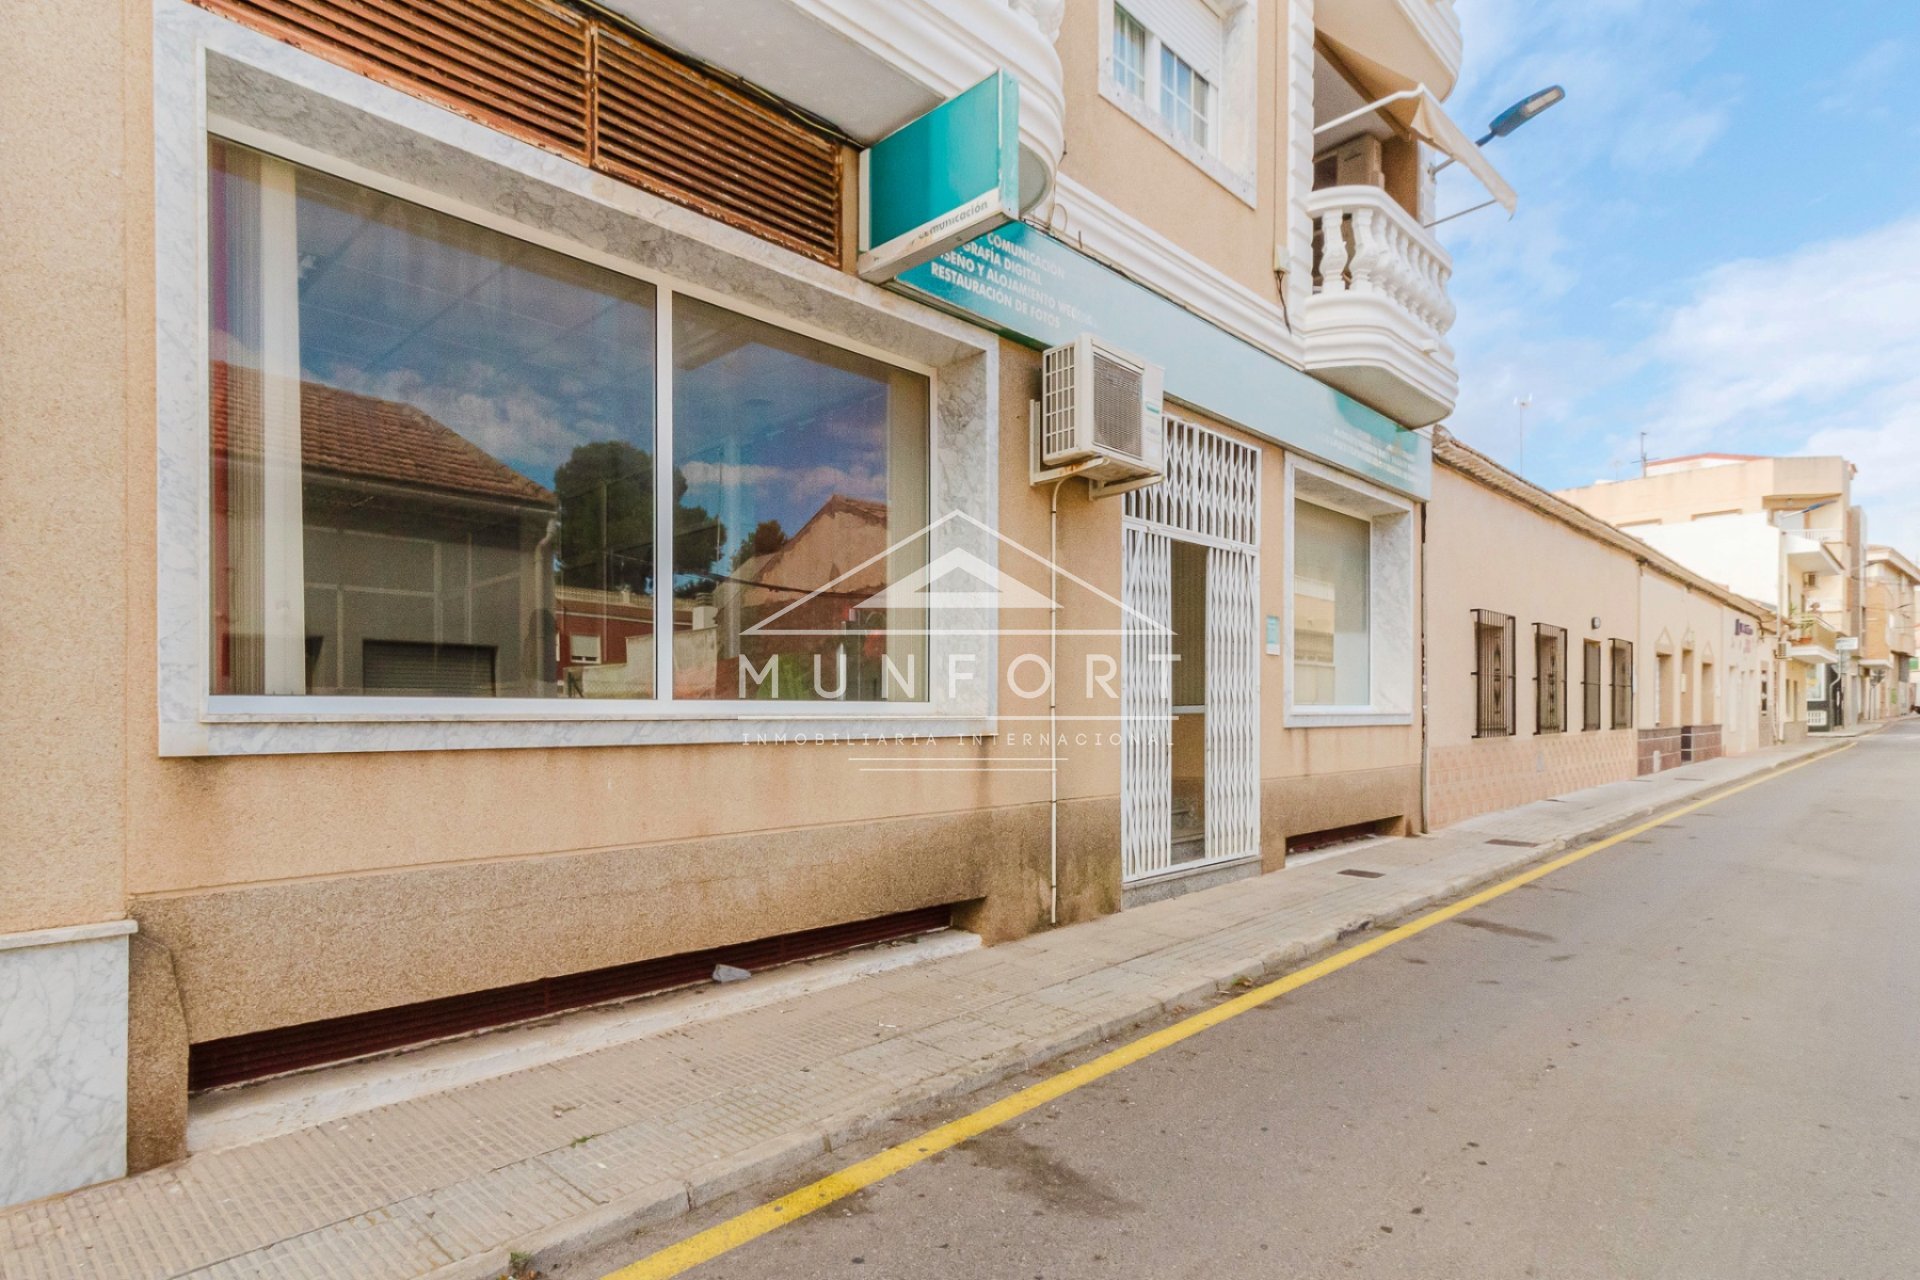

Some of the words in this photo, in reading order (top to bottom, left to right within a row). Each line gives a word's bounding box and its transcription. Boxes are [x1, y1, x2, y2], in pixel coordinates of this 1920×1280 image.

[930, 261, 1012, 308] RESTAURACIÓN
[1015, 299, 1028, 316] DE
[1029, 305, 1061, 329] FOTOS
[976, 262, 985, 277] Y
[986, 267, 1056, 310] ALOJAMIENTO
[1003, 257, 1042, 286] DIGITAL
